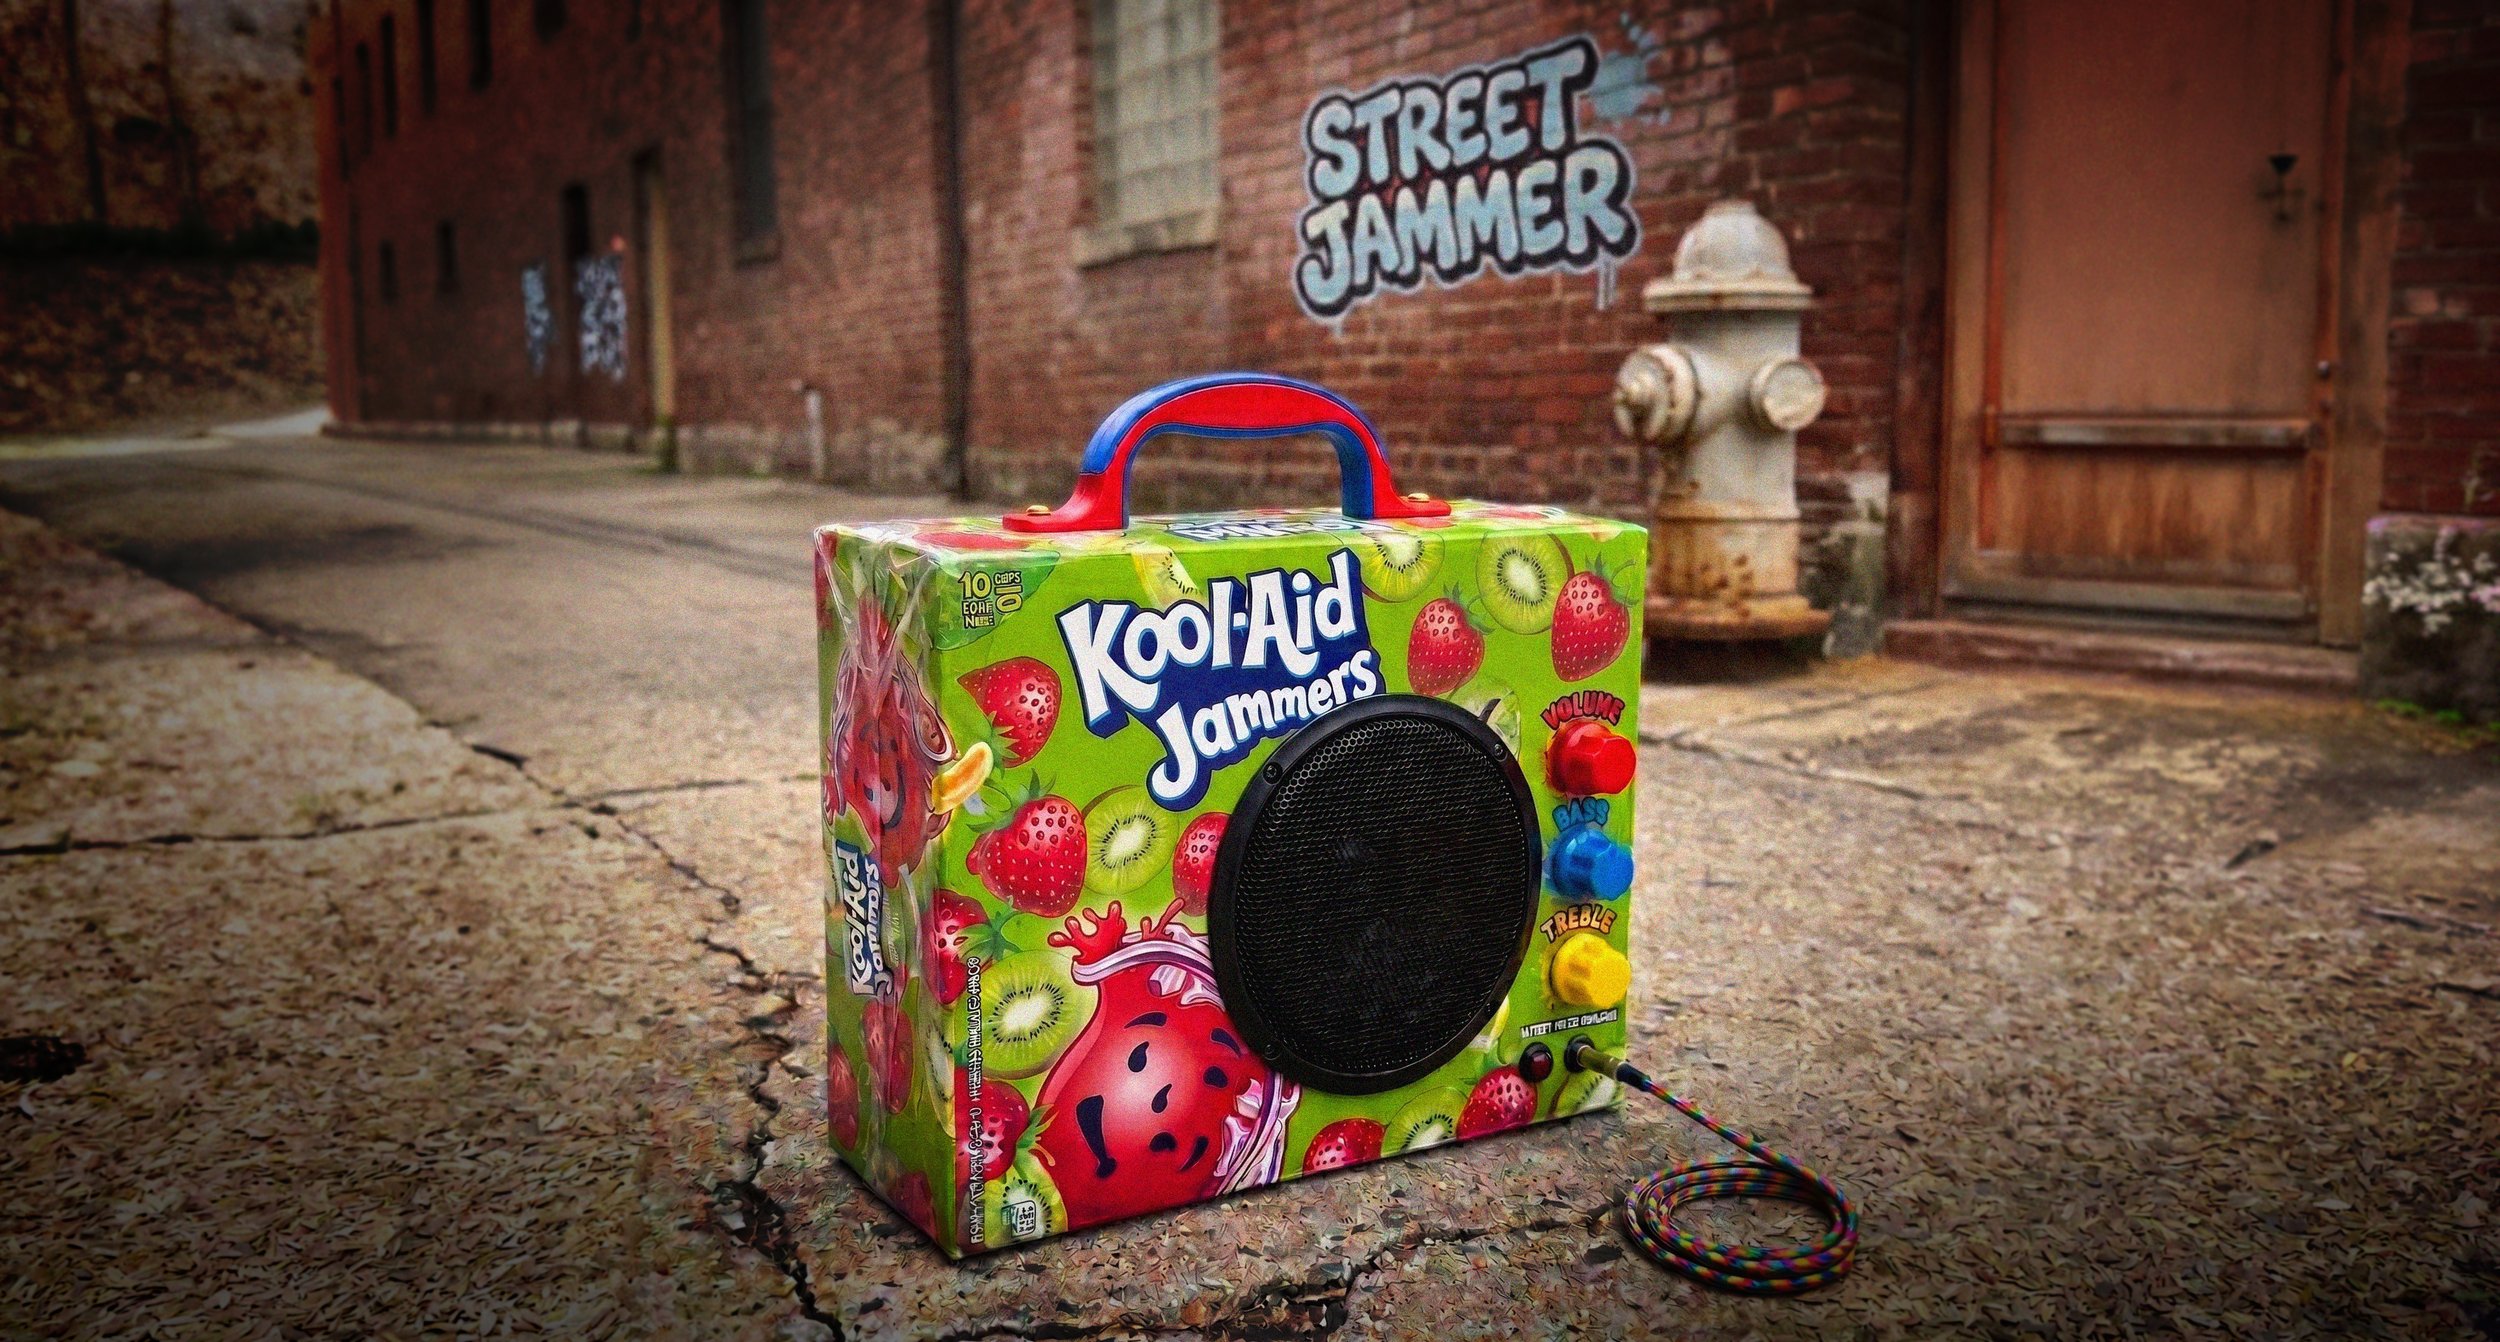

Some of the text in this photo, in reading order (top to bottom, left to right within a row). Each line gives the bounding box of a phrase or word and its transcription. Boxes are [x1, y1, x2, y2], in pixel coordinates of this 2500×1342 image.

[1307, 40, 1594, 200] STREET
[1299, 140, 1635, 312] JAMMER
[959, 571, 992, 599] 10
[1058, 549, 1364, 730] Kool-Aid
[1147, 647, 1381, 804] Jammers
[1540, 690, 1625, 730] VOLUME
[1552, 797, 1610, 832] BASS
[838, 843, 875, 995] Kool-Aid
[1539, 903, 1618, 943] TREBLE
